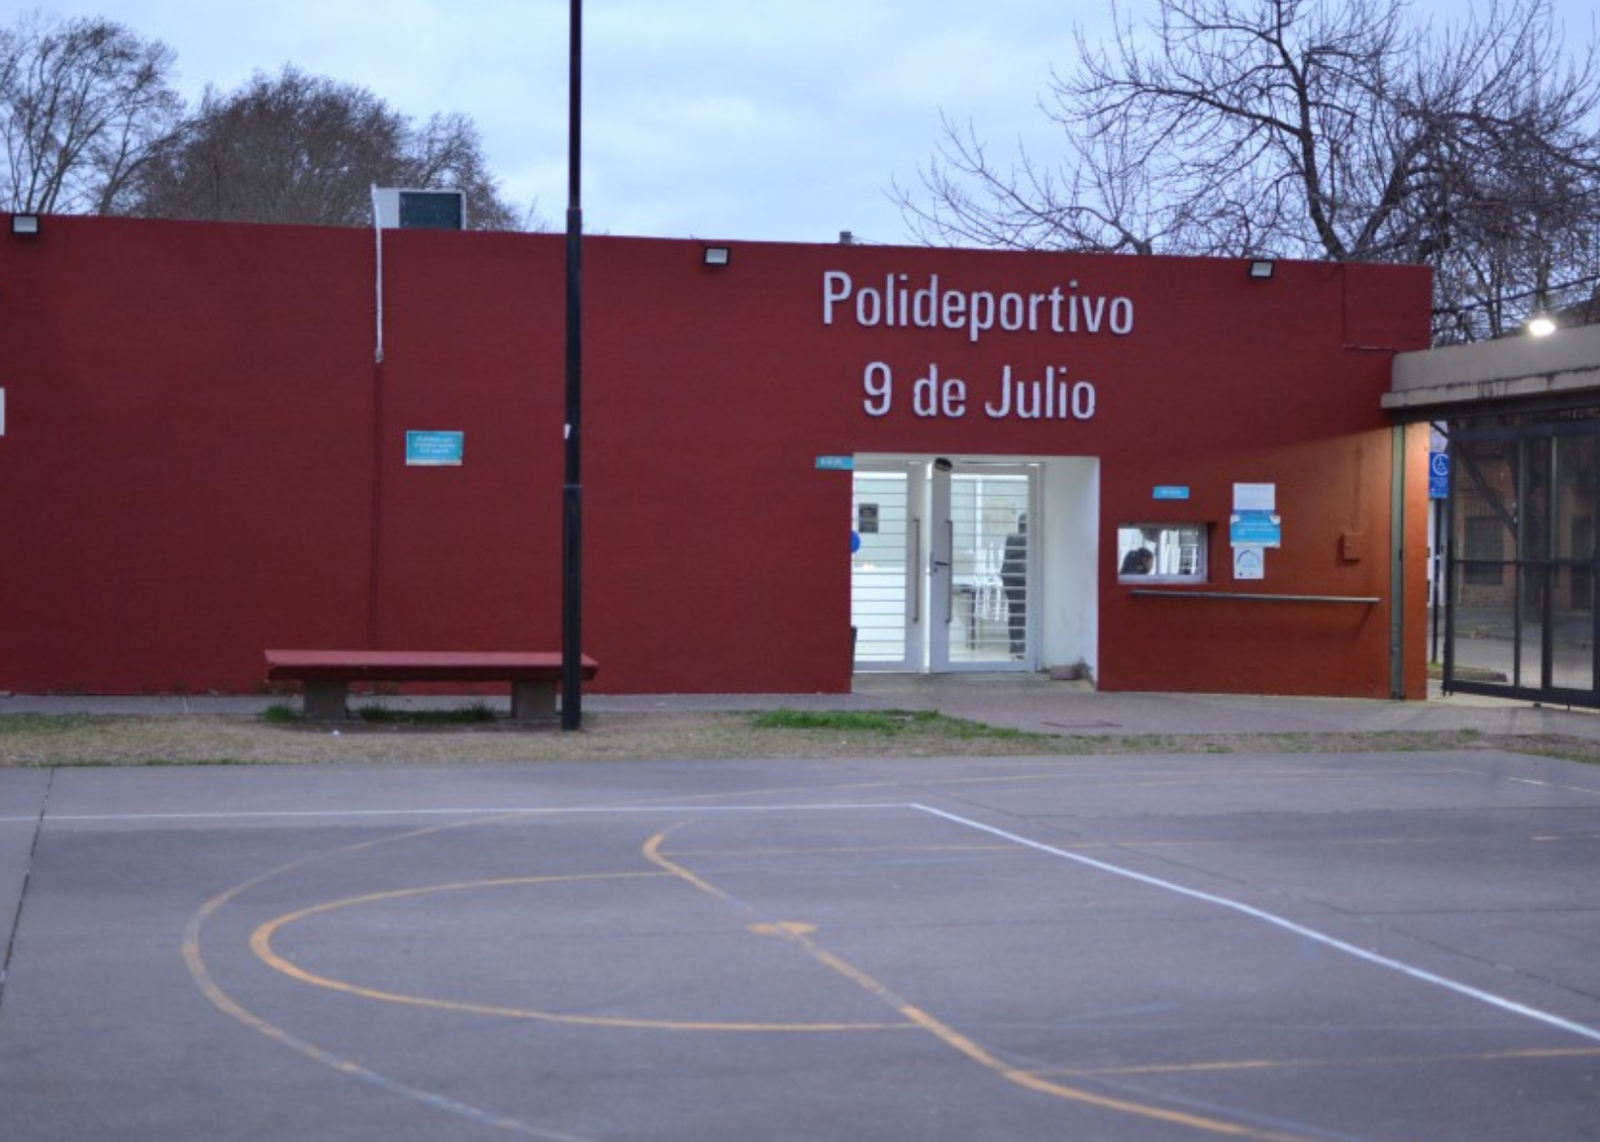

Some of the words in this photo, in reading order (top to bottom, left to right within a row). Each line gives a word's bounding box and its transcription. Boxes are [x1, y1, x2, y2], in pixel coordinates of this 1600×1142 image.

[823, 271, 1134, 342] Polideportivo
[863, 361, 892, 415] 9
[913, 363, 966, 417] de
[984, 365, 1096, 419] Julio
